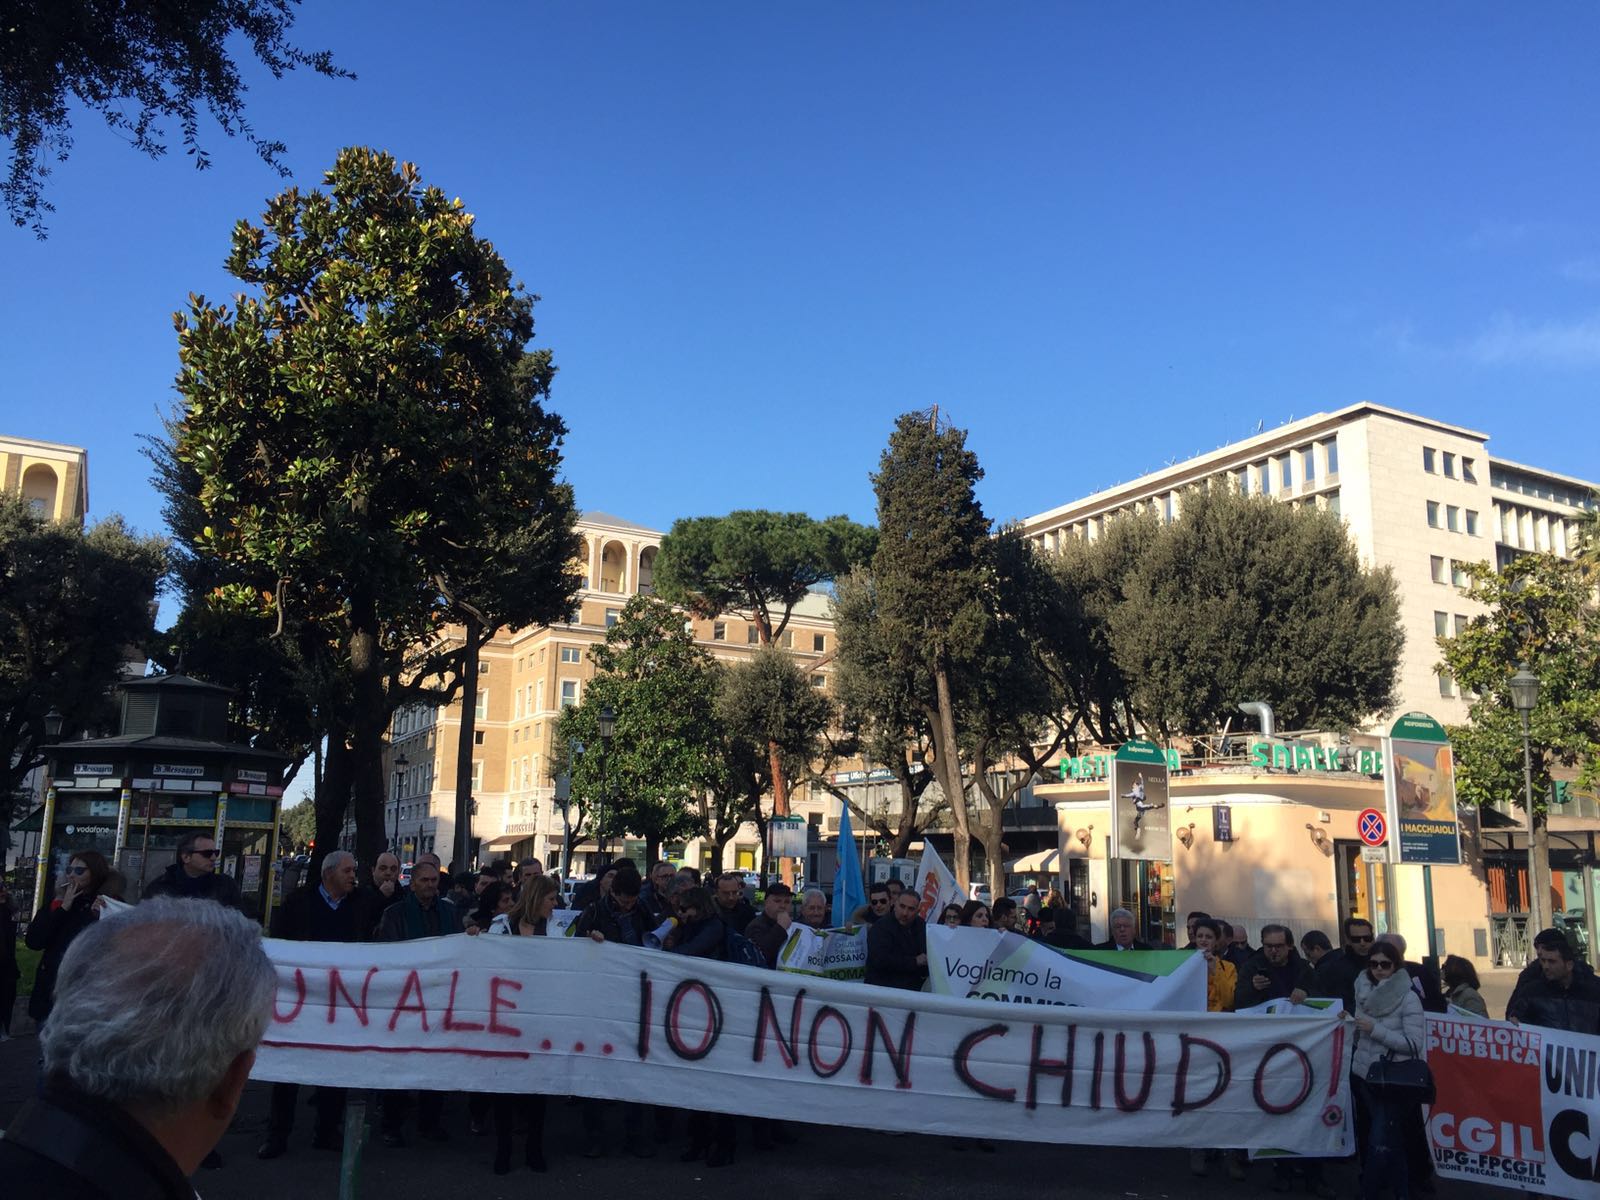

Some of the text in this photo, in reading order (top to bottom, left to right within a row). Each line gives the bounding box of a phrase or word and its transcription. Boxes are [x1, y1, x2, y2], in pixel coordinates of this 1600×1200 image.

[1251, 743, 1341, 770] SNACK
[76, 825, 110, 834] vodafone
[1405, 823, 1456, 835] MACCHIAIOLI
[945, 956, 1062, 991] Vogliamo la
[752, 985, 917, 1090] NON
[1426, 1020, 1542, 1051] FUNZIONE
[1426, 1036, 1541, 1067] PUBBLICA
[1545, 1043, 1600, 1100] UNI
[1431, 1112, 1546, 1163] CGIL
[1434, 1148, 1547, 1179] UPG-FPCGIL
[1464, 1166, 1500, 1179] PRECARI
[1502, 1172, 1547, 1187] GIUSTIZIA
